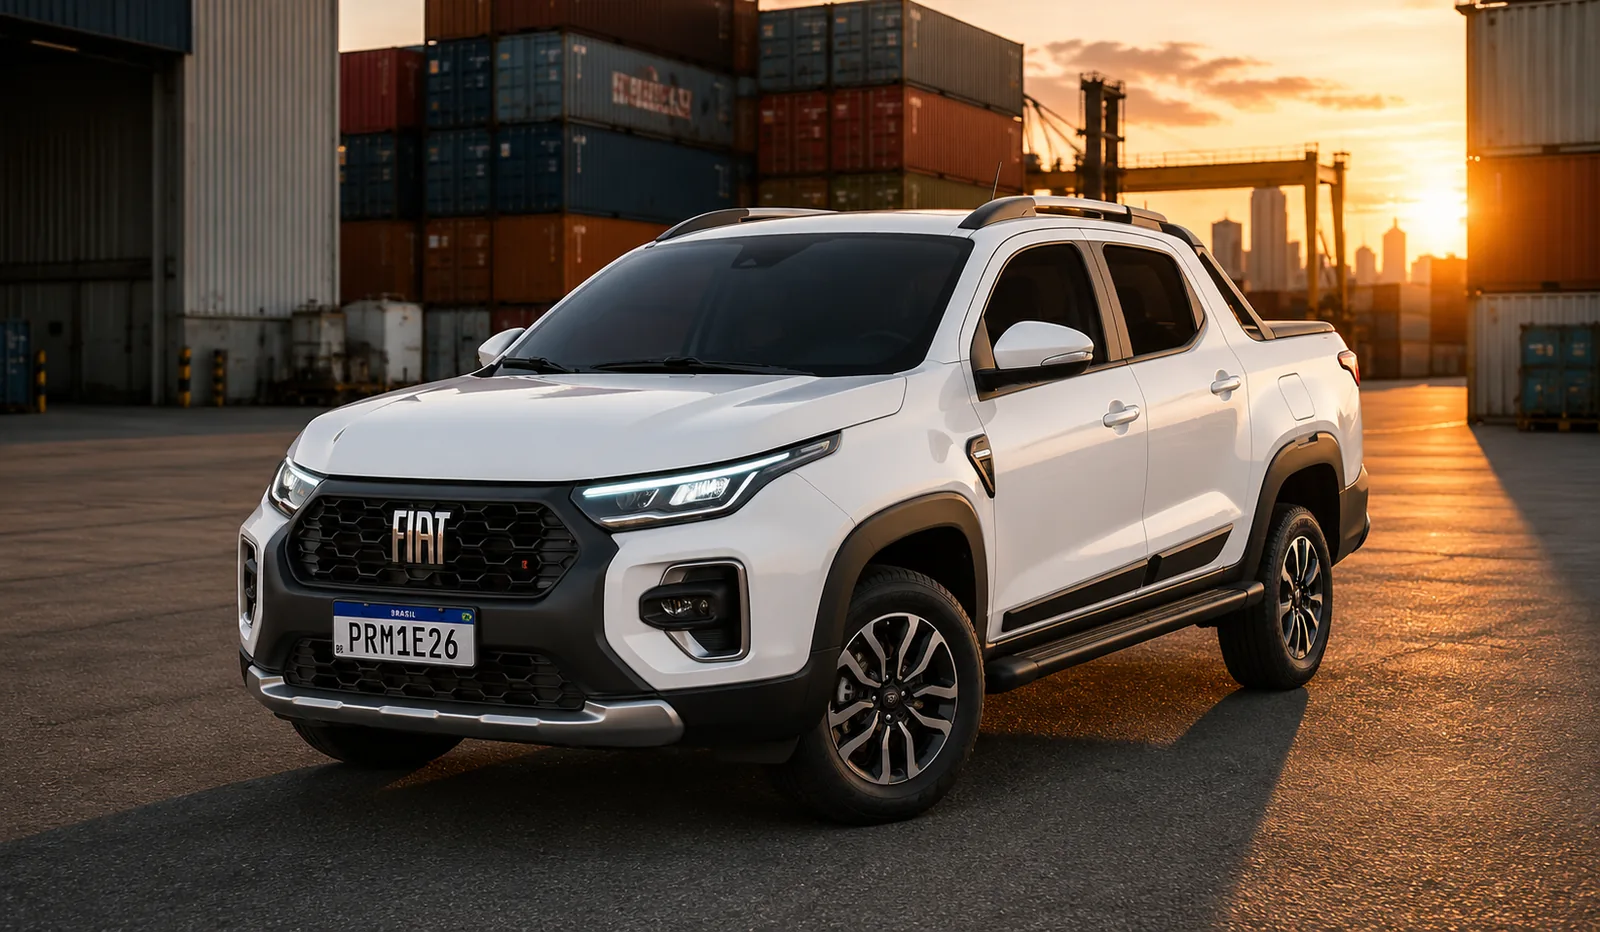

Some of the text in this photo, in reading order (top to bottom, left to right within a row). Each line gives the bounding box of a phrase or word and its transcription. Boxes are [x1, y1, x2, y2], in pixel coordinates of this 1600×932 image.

[392, 510, 451, 565] FIAT
[391, 609, 416, 618] BRASIL
[349, 622, 458, 660] PRM1E26
